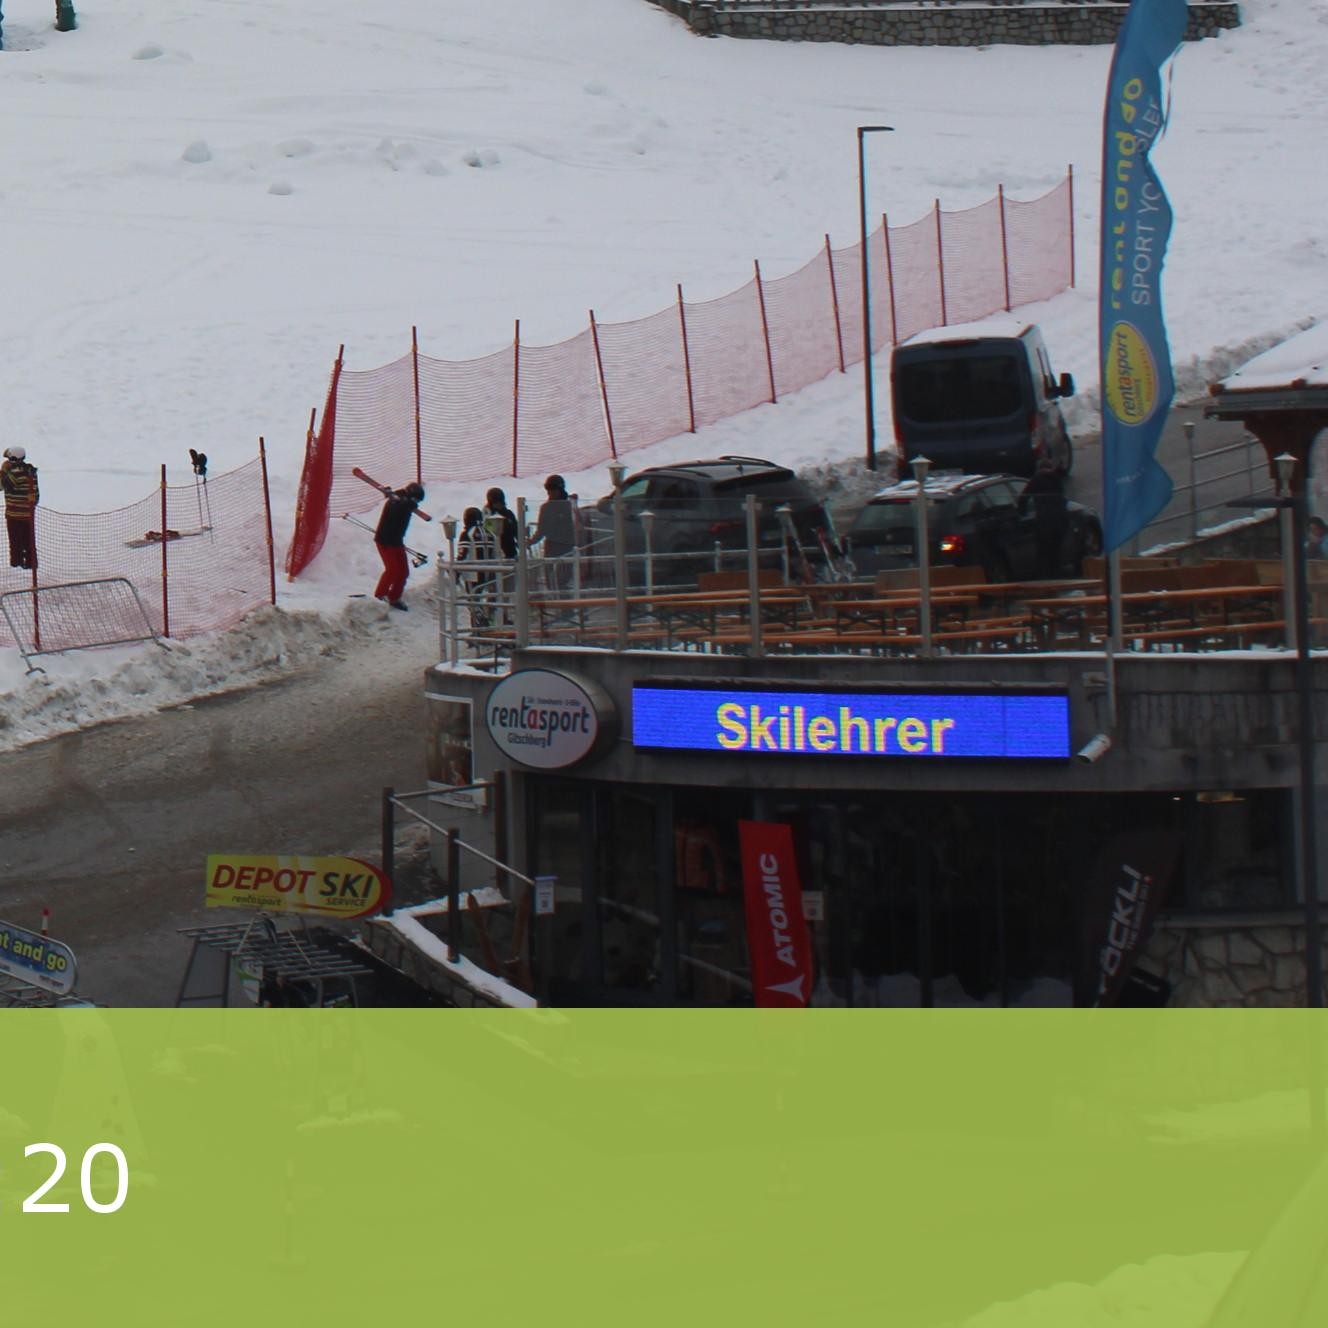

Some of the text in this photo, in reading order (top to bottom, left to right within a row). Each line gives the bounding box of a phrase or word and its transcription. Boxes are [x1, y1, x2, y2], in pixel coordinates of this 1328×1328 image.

[1114, 130, 1137, 210] and
[1111, 220, 1126, 310] rent
[1131, 219, 1155, 306] SPORT
[1116, 330, 1136, 418] rentasport
[491, 696, 590, 747] rentasport
[716, 702, 955, 753] Skilehrer
[212, 864, 373, 898] DEPOT SKI
[325, 897, 368, 907] SERVICE
[759, 853, 797, 968] ATOMIC
[12, 939, 43, 962] and
[47, 952, 66, 970] go
